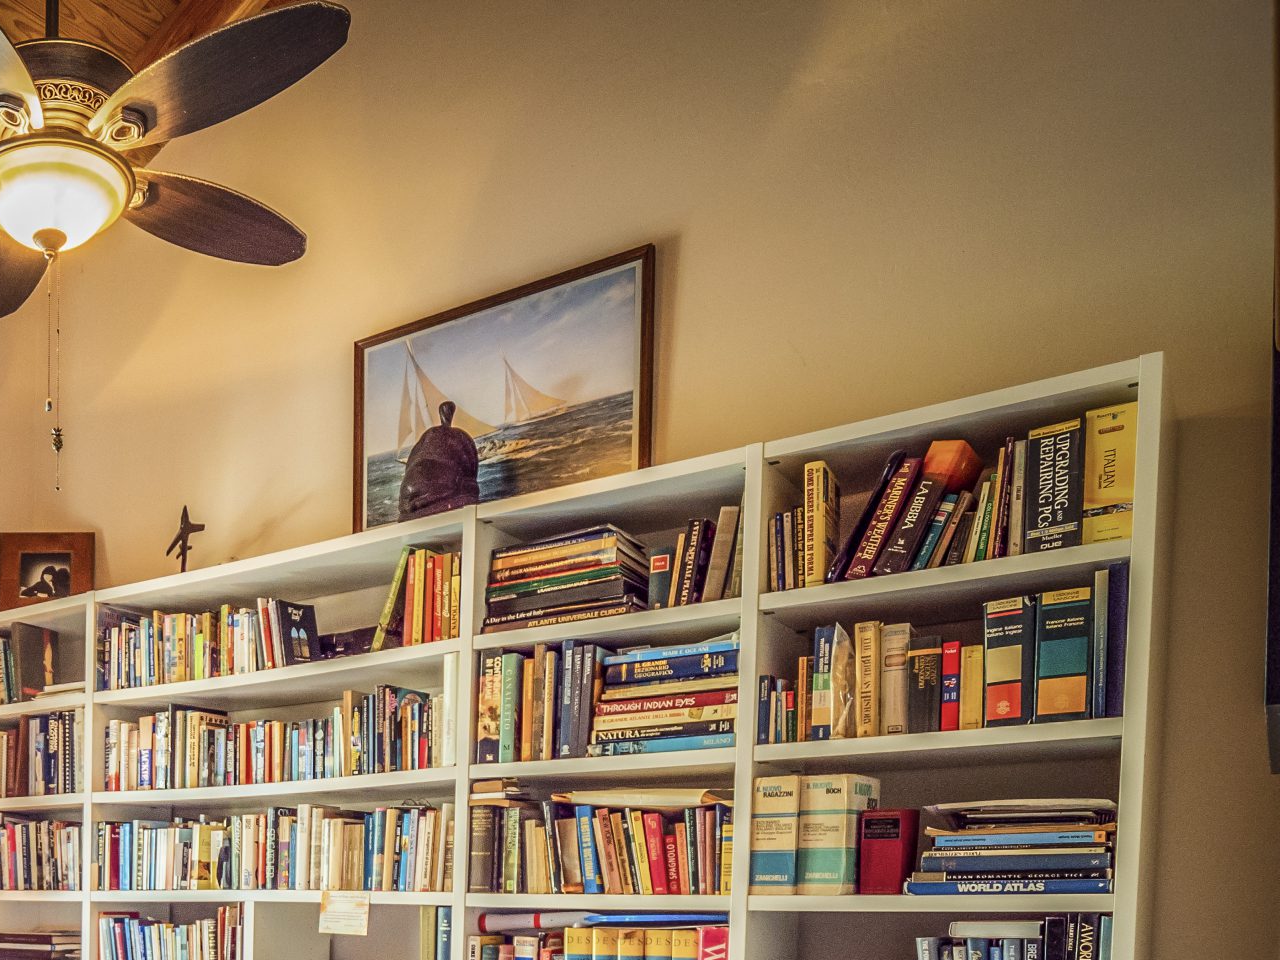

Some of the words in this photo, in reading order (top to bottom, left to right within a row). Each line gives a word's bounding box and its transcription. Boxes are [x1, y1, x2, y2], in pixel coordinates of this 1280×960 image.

[806, 468, 814, 485] COME
[1038, 436, 1054, 504] REPAIRING
[1055, 433, 1070, 509] UPGRADING
[1103, 448, 1117, 489] ITALIAN
[920, 480, 933, 494] LA
[882, 477, 907, 521] MARINER'S
[902, 496, 926, 530] BIBBIA
[983, 503, 992, 529] COLLOQUIAL
[1038, 507, 1052, 528] PCs
[690, 526, 700, 546] VERY
[861, 520, 889, 560] WEATHER
[979, 532, 987, 550] ITALIAN
[807, 544, 814, 552] IN
[684, 546, 696, 579] SPECIAL
[807, 553, 815, 577] FORMA
[528, 617, 557, 628] ATLANTE
[558, 611, 599, 623] UNIVERSALE
[600, 607, 626, 617] CURCIO
[684, 646, 709, 654] OCEANI
[863, 637, 871, 653] THE
[486, 658, 494, 667] IN
[634, 664, 669, 673] DIZIONARIO
[642, 660, 668, 668] GRANDE
[861, 655, 872, 679] BIBLE
[634, 669, 674, 679] GEOGRAFICO
[863, 680, 872, 689] AS
[504, 669, 513, 730] CANALETTO
[601, 701, 641, 713] THROUGH
[643, 699, 673, 710] INDIAN
[675, 697, 696, 707] EYES
[861, 690, 872, 725] HISTORY
[598, 729, 640, 741] NATURA
[703, 737, 731, 746] MILANO
[763, 790, 794, 798] RAGAZZINI
[825, 787, 842, 795] BOCH
[602, 814, 610, 829] NEW
[604, 830, 613, 846] YORK
[666, 843, 678, 880] SPAGNOLO
[755, 874, 788, 882] ZANICHELLI
[957, 883, 1002, 893] WORLD
[1003, 882, 1045, 892] ATLAS
[1081, 923, 1094, 932] A
